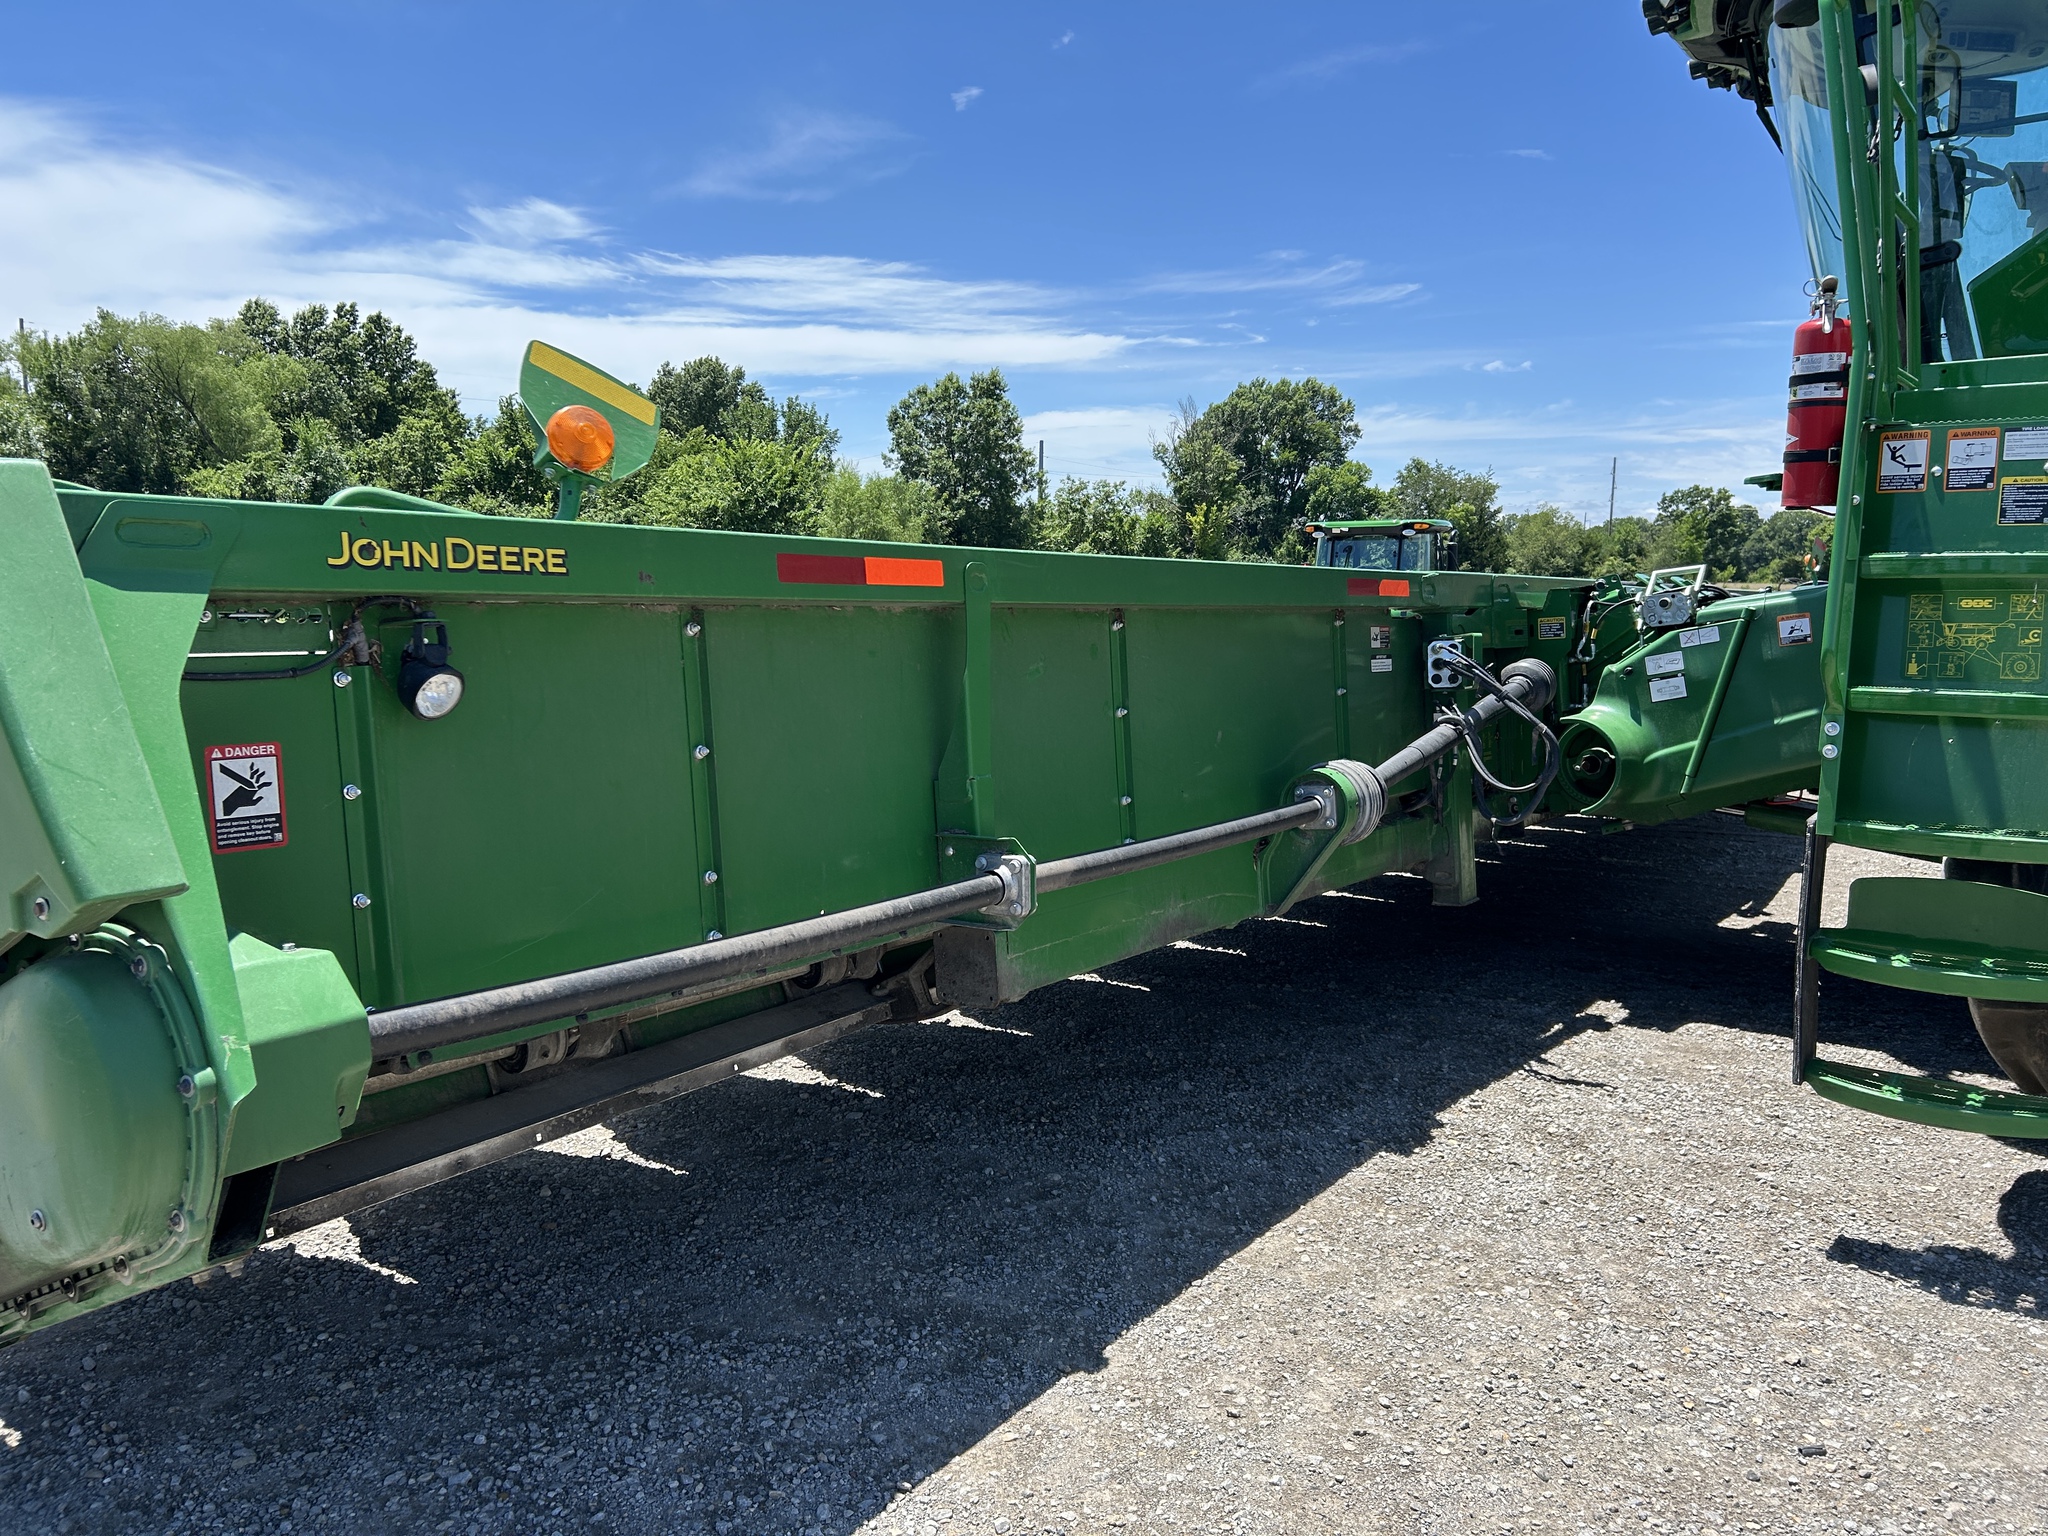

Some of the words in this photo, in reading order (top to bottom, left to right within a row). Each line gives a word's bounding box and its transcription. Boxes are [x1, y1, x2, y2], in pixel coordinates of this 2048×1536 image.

[1961, 429, 1996, 437] WARNING
[327, 531, 440, 570] JOHN
[444, 537, 568, 575] DEERE
[225, 745, 275, 757] DANGER
